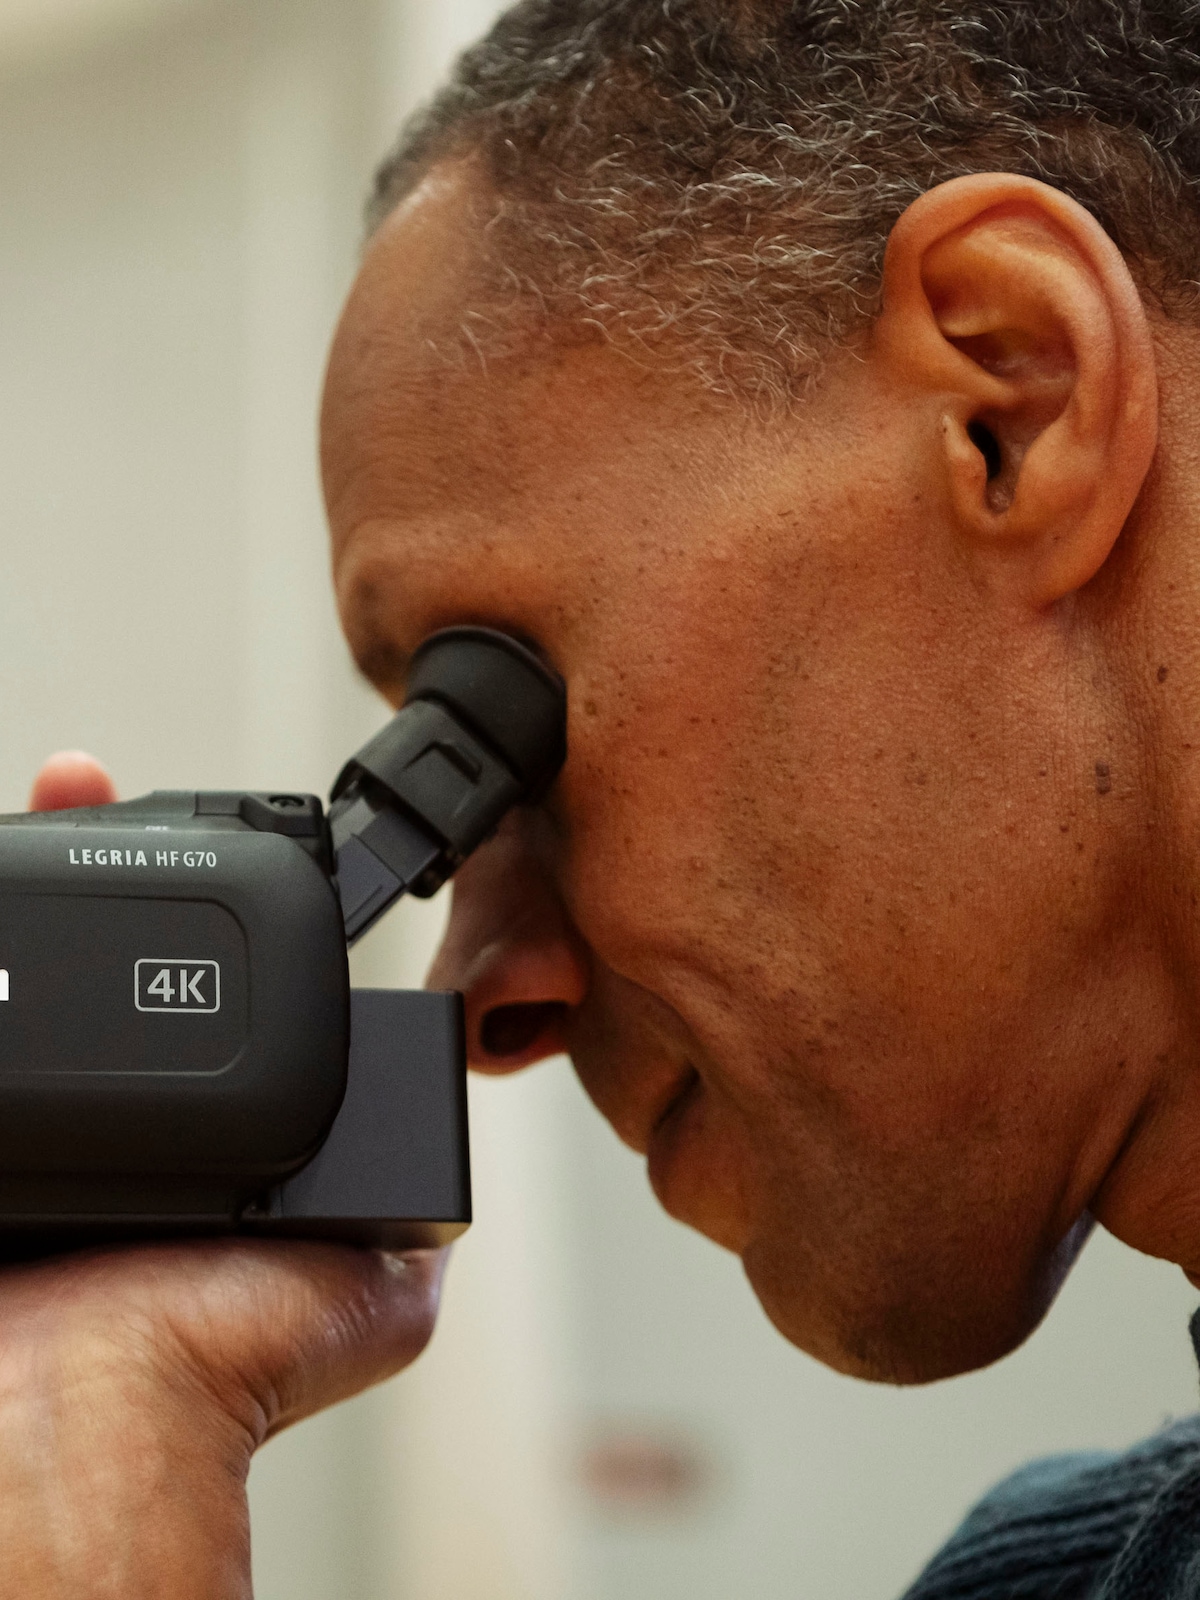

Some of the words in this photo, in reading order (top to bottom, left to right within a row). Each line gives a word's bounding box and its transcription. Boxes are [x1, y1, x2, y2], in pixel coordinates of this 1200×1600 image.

[68, 848, 148, 867] LEGRIA
[155, 850, 179, 867] HF
[182, 851, 218, 868] G70
[146, 967, 207, 1004] 4K
